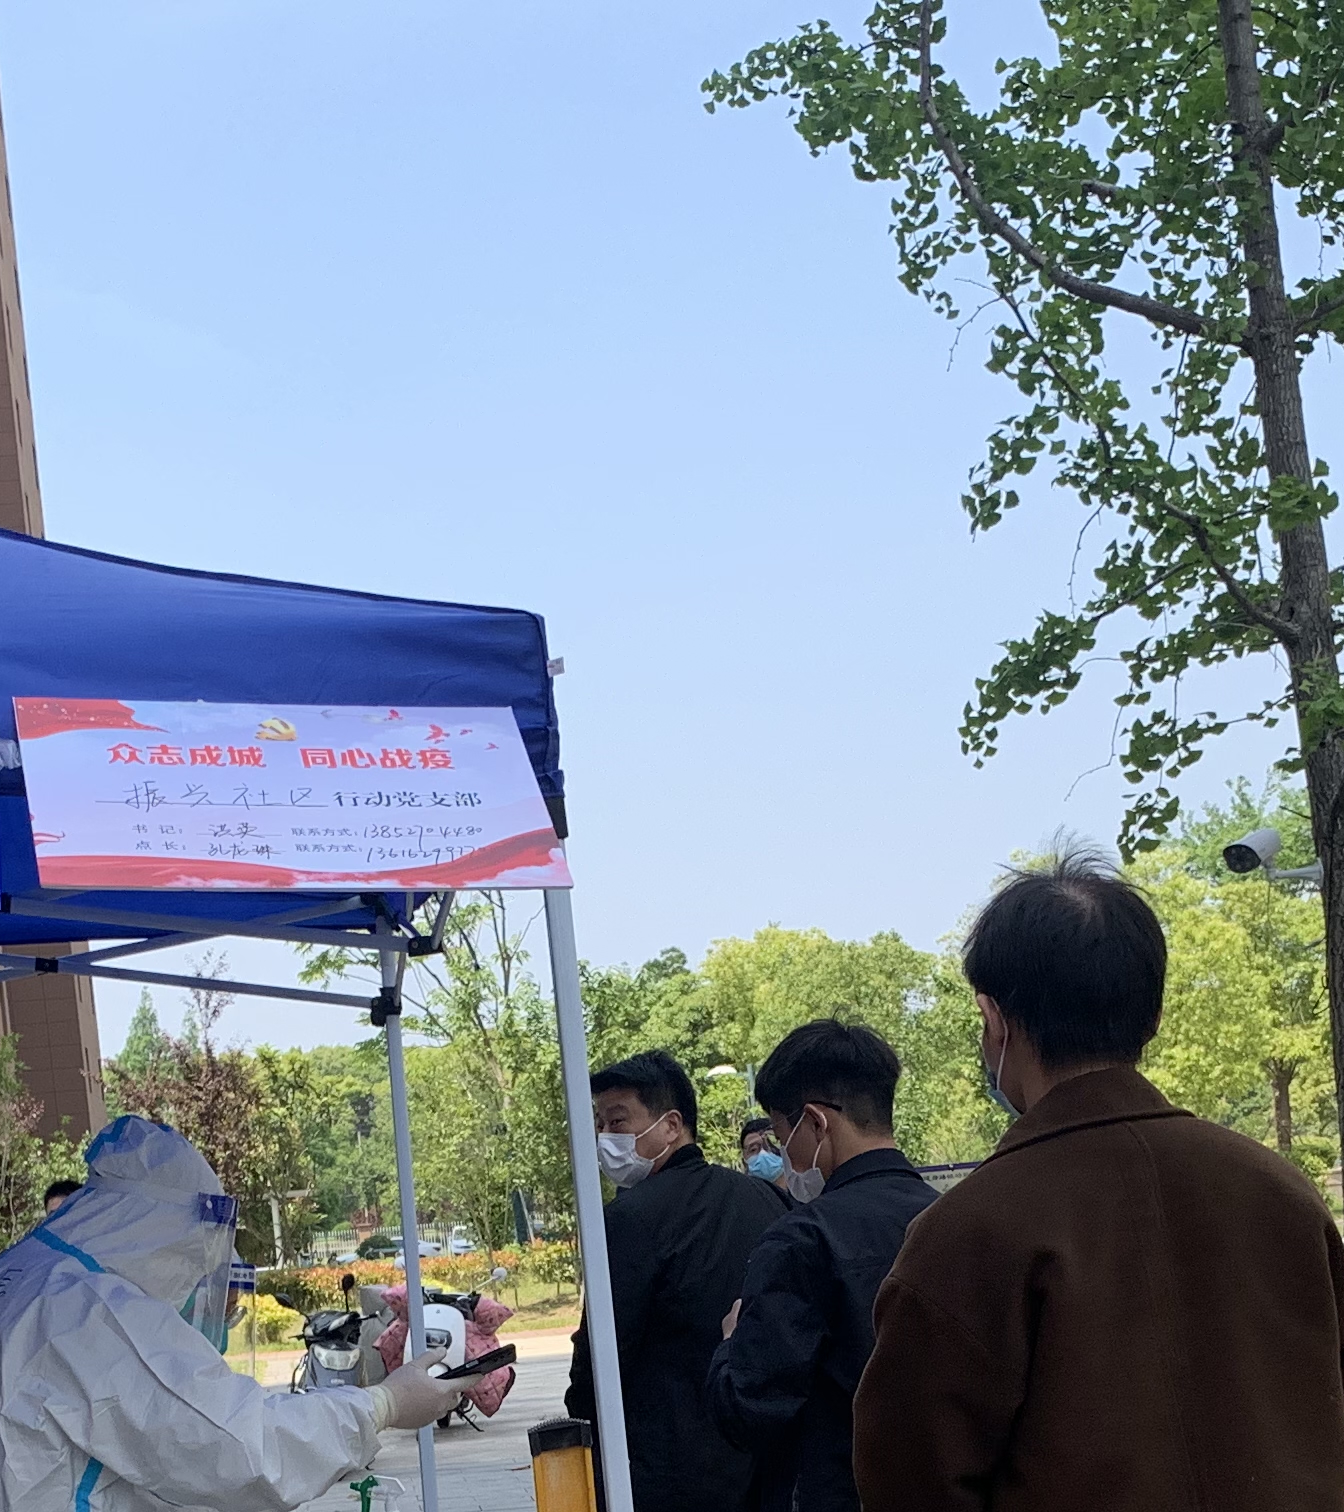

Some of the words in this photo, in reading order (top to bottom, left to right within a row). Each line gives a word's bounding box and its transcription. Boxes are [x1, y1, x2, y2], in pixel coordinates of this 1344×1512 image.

[106, 743, 268, 768] 众志成城
[299, 746, 456, 771] 同心战疫
[333, 790, 483, 808] 行动党支部
